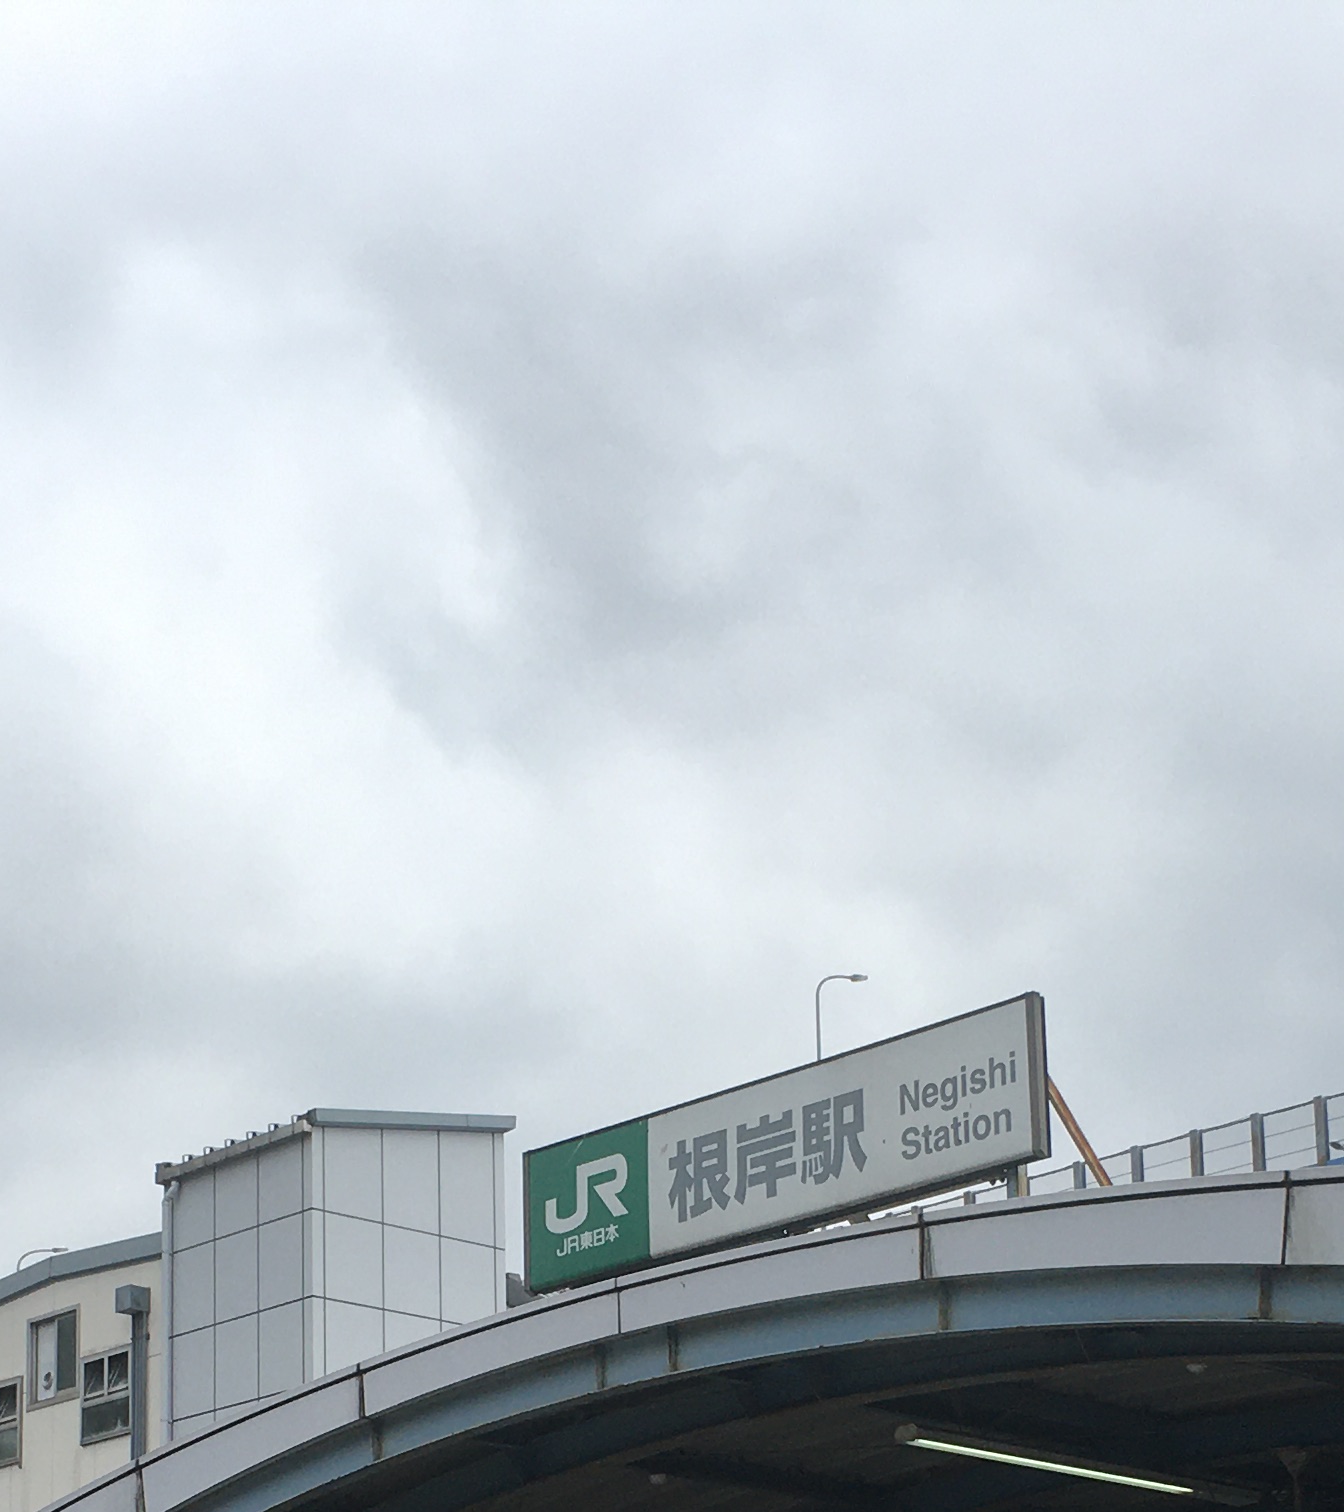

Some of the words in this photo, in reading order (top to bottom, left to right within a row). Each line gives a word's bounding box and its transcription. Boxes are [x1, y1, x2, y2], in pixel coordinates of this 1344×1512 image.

[899, 1051, 1017, 1115] Negishi
[668, 1088, 868, 1224] 根岸駅
[900, 1106, 1013, 1160] Station
[545, 1153, 628, 1234] JR
[556, 1223, 620, 1258] JR東日本
